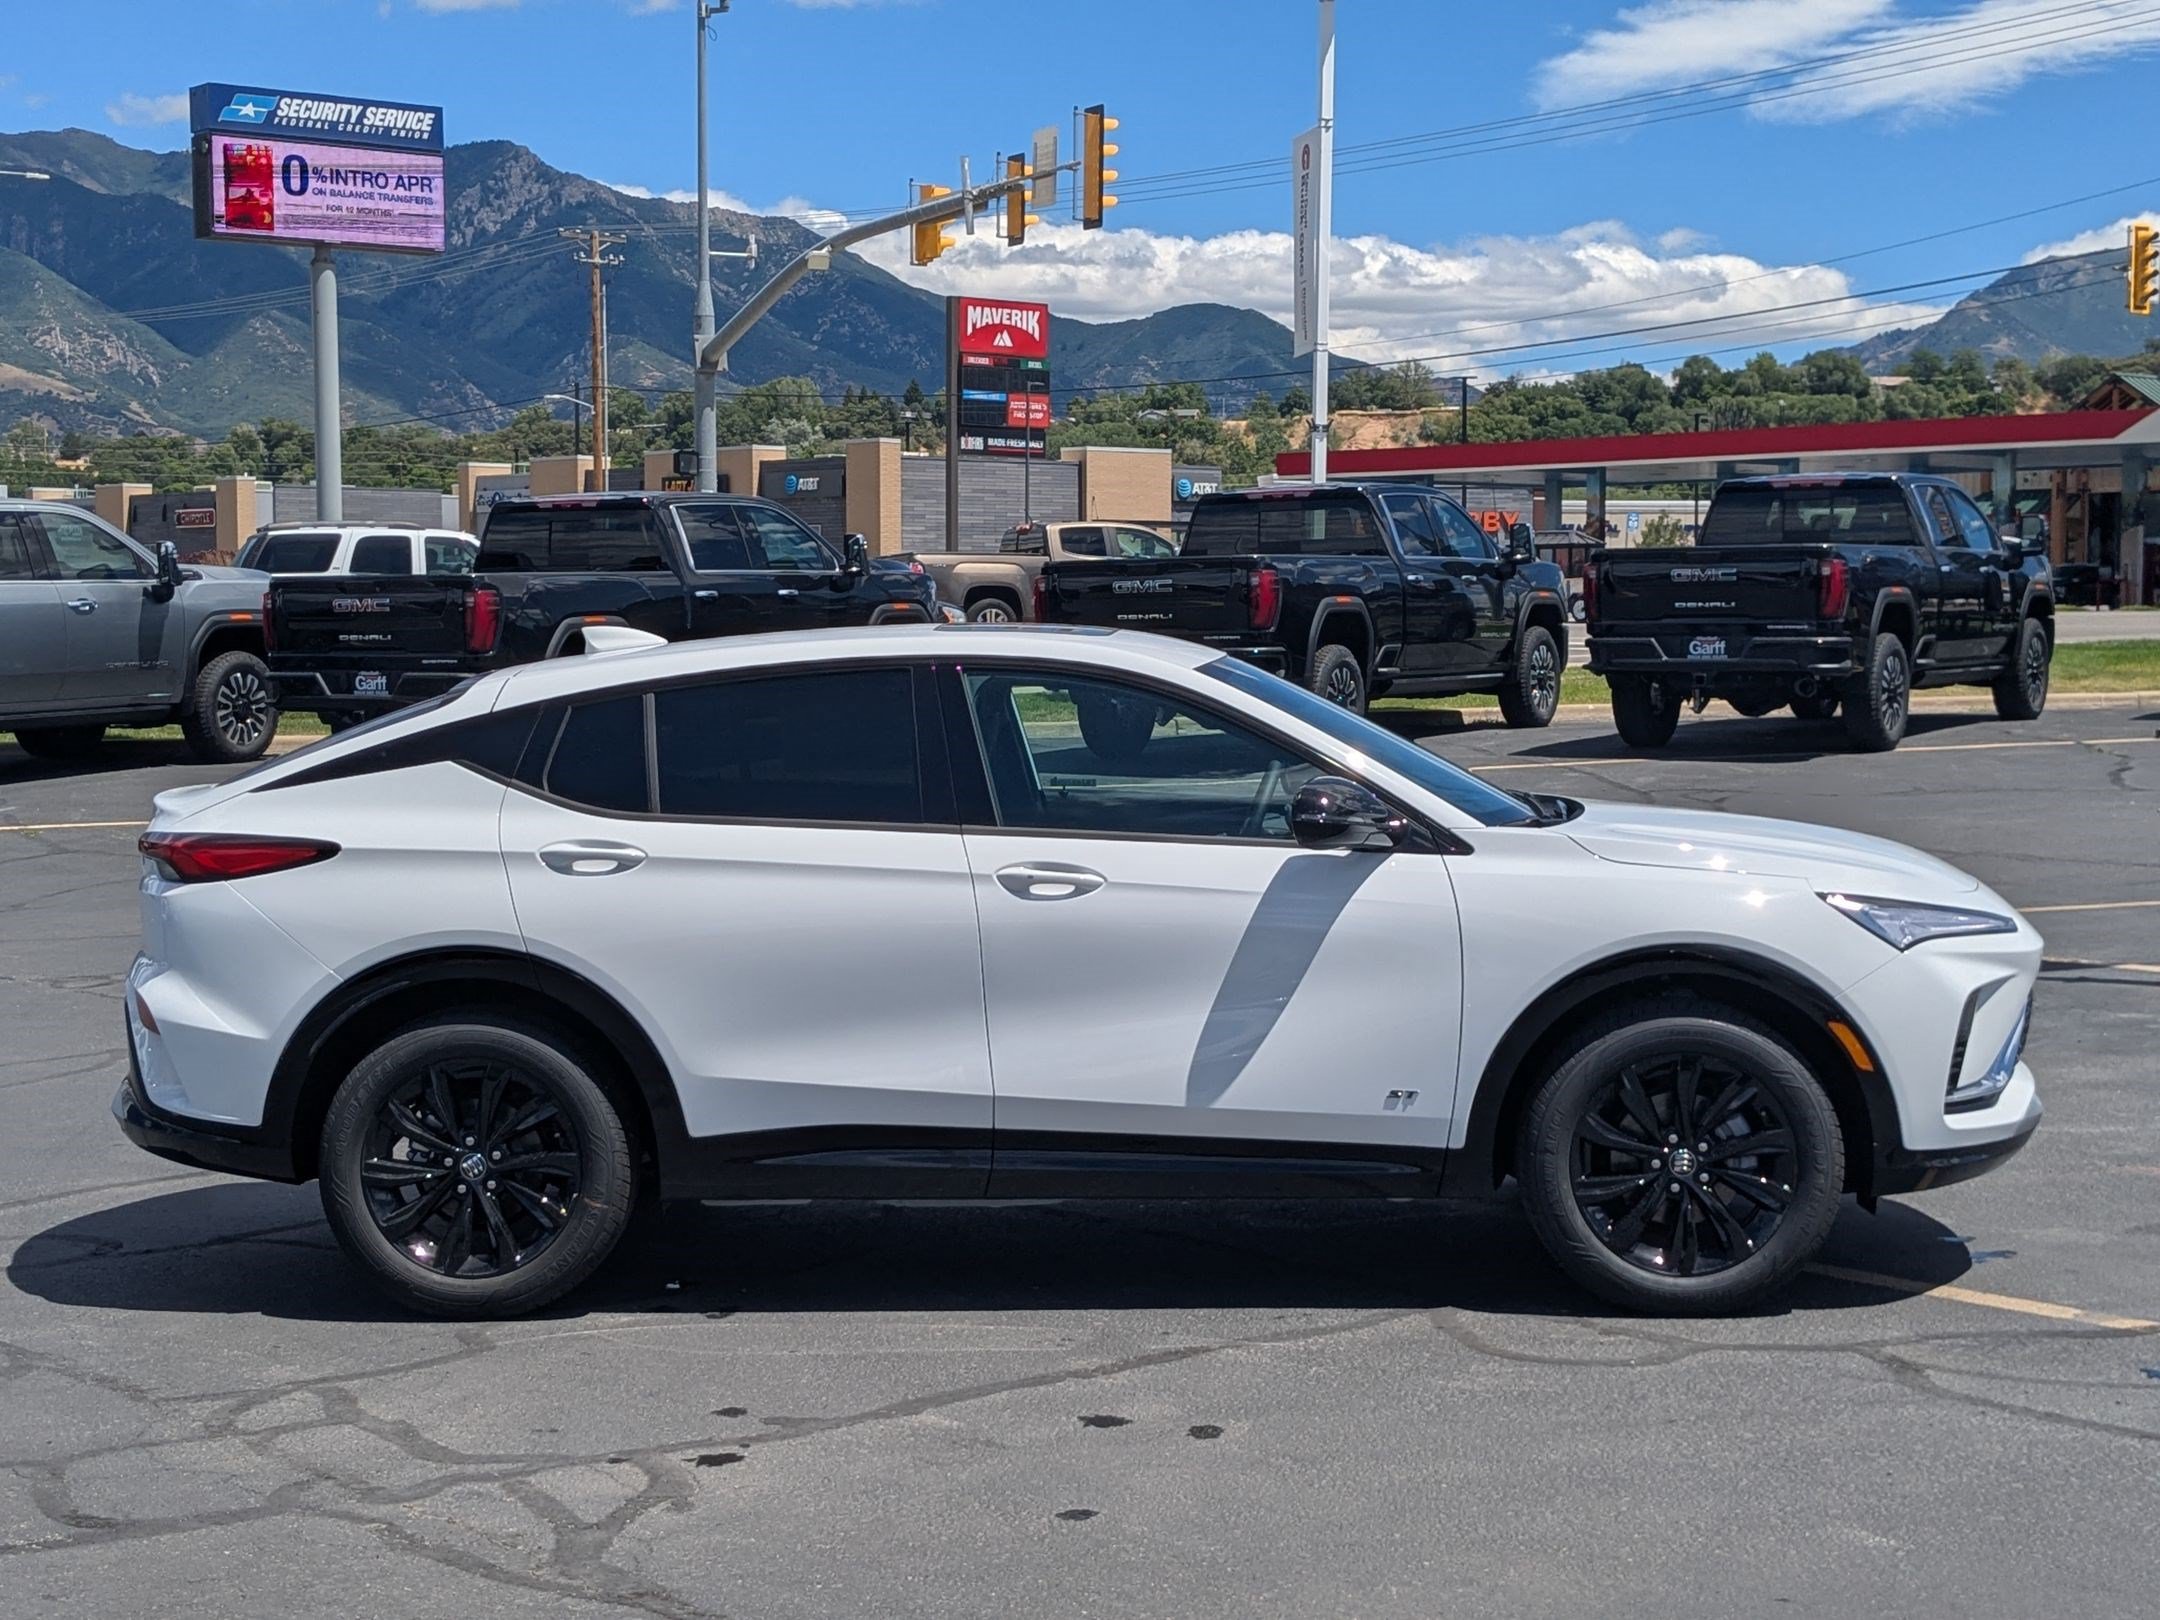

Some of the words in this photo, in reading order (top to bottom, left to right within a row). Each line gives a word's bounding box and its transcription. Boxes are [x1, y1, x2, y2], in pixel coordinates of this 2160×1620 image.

[277, 97, 363, 124] SECURITY
[363, 107, 435, 131] SERVICE
[274, 117, 330, 130] FEDERAL
[338, 124, 384, 136] CREDIT
[391, 128, 430, 140] UNION
[330, 168, 388, 190] INTRO
[312, 187, 327, 197] ON
[329, 189, 375, 201] BALANCE
[377, 192, 434, 206] TRANSFERS
[326, 204, 343, 213] FOR
[966, 305, 1040, 341] MAVERIK
[797, 477, 819, 490] AT&T
[1192, 482, 1217, 494] AT&T
[1670, 568, 1737, 582] GMC
[1112, 579, 1173, 594] GMC
[332, 598, 390, 612] GMC
[1689, 640, 1727, 655] Garff
[355, 675, 387, 690] Garff
